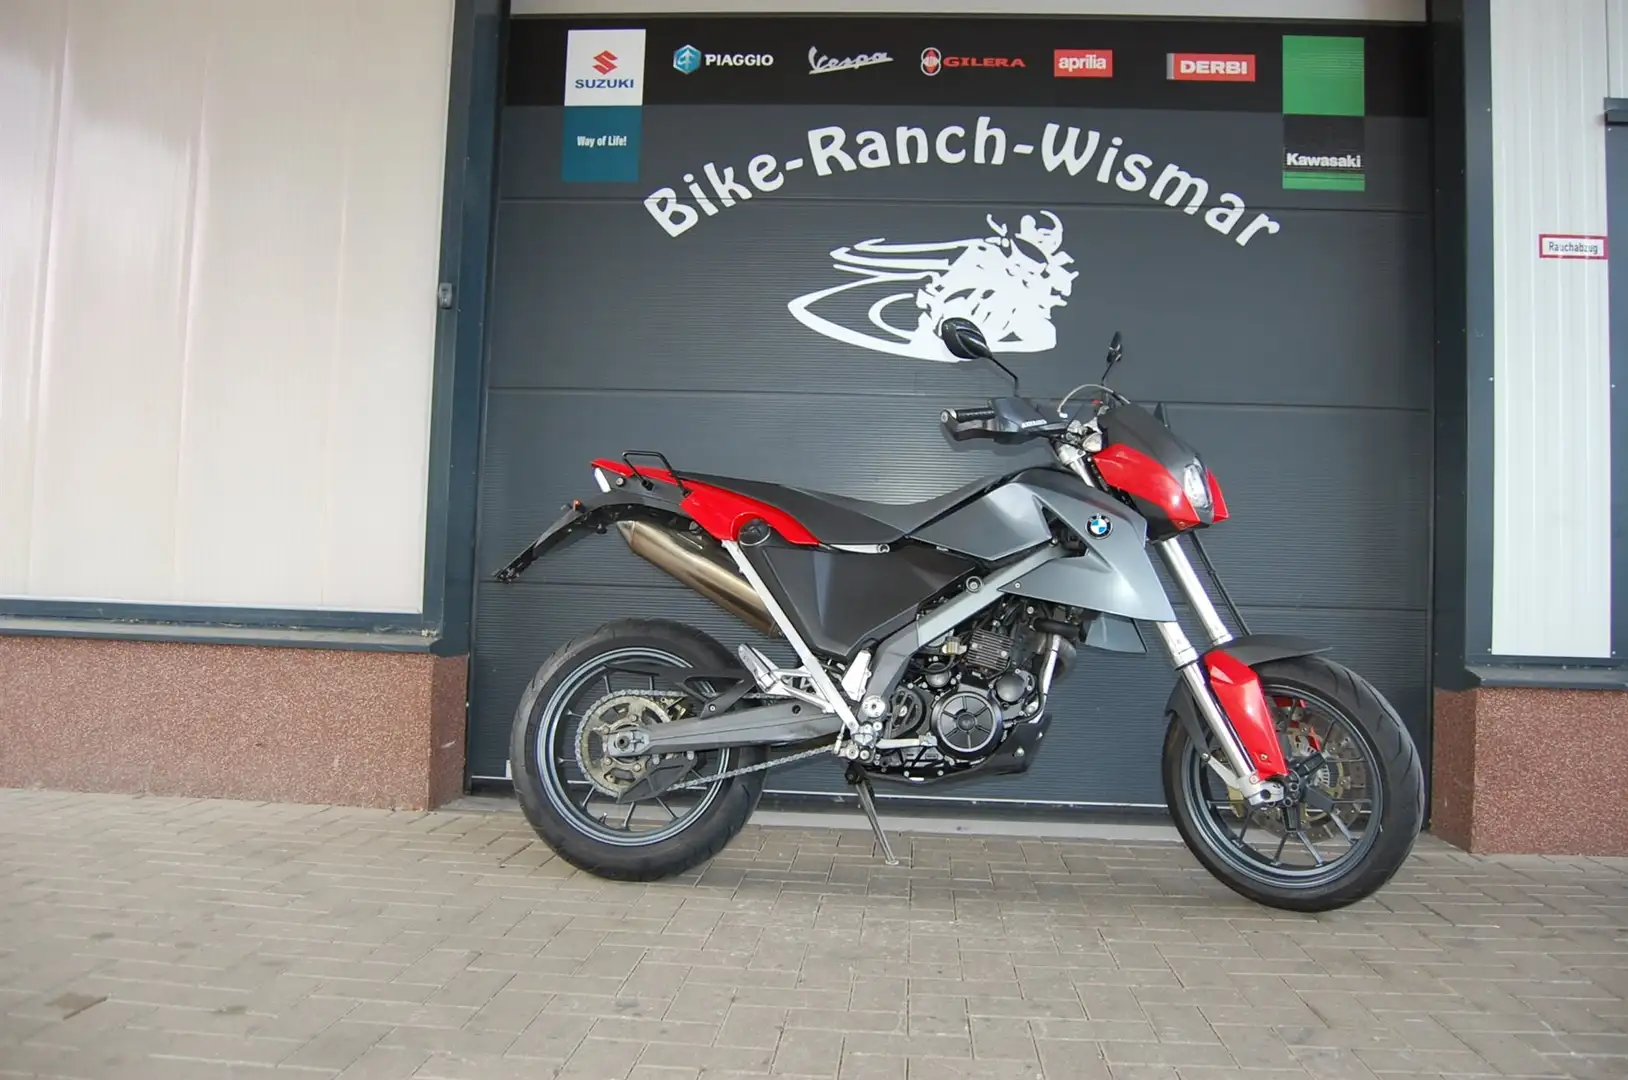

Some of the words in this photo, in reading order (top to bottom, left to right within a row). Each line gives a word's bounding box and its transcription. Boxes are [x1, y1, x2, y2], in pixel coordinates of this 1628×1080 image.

[705, 54, 774, 66] PIAGGIO
[808, 46, 893, 74] Vespa
[943, 56, 1027, 68] GILERA
[1058, 54, 1107, 73] aprilia
[1180, 60, 1248, 75] DERBI
[575, 78, 634, 89] SUZUKI
[577, 135, 595, 148] Way
[596, 135, 607, 147] of
[607, 135, 627, 147] Life!
[1286, 152, 1361, 168] Kawasaki
[643, 116, 1280, 247] Bike-Ranch-Wismar
[1548, 241, 1598, 254] Rauchabzug
